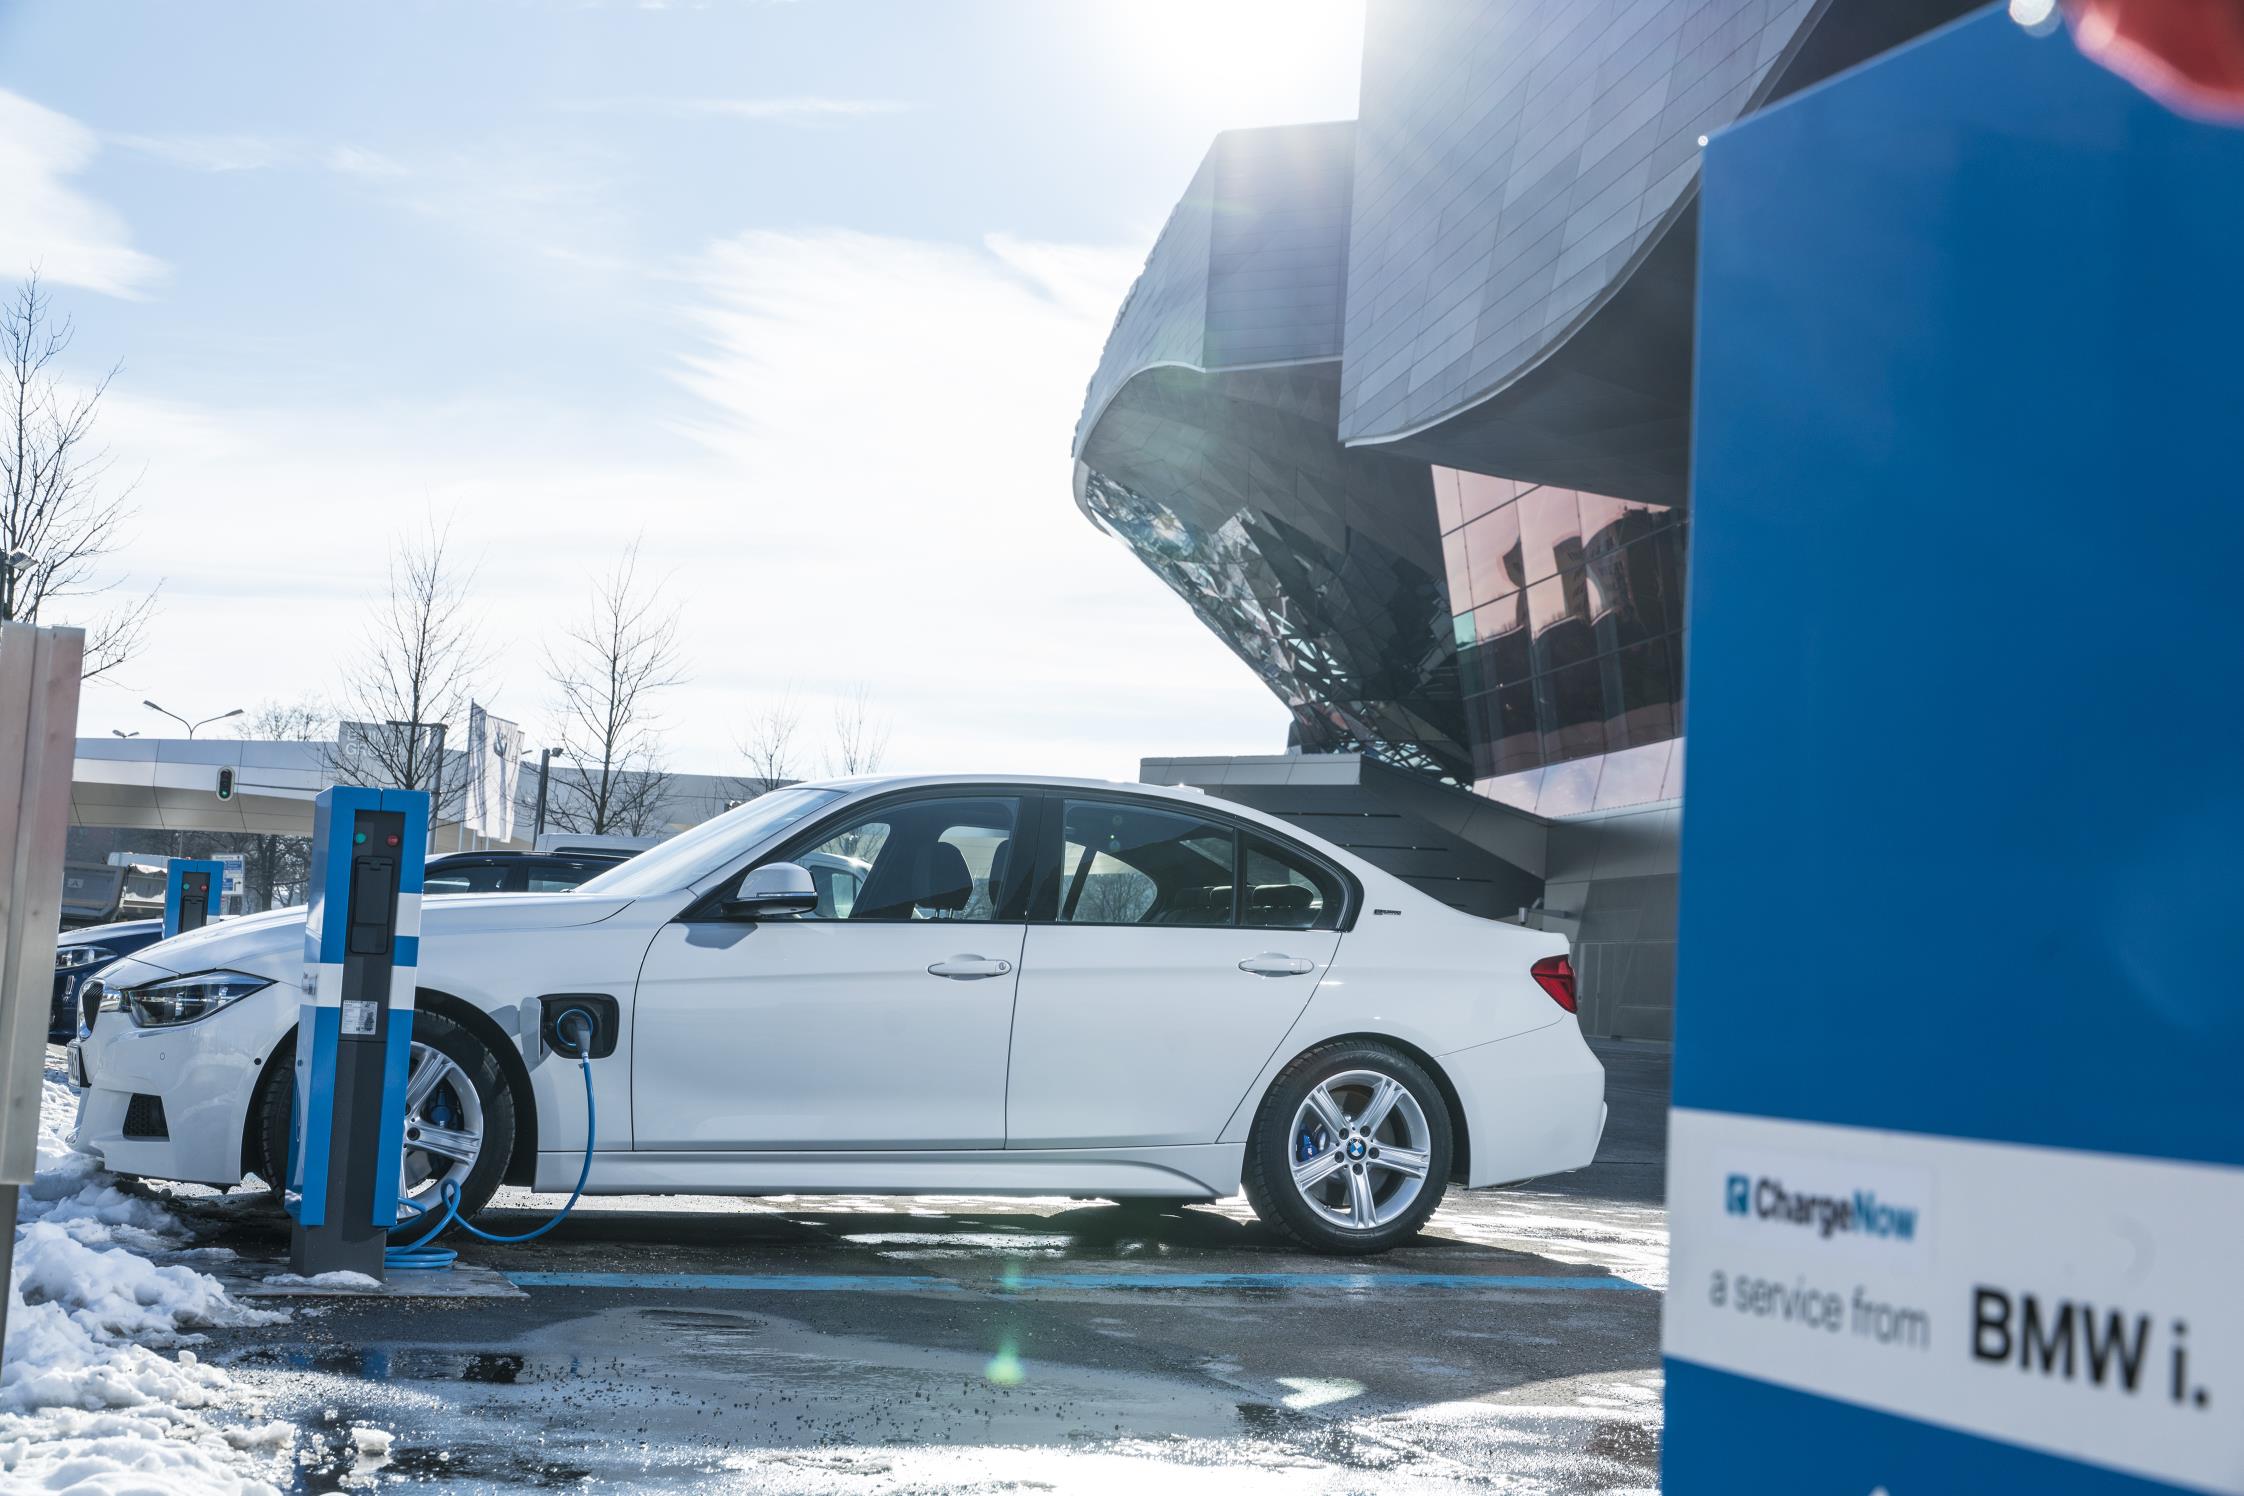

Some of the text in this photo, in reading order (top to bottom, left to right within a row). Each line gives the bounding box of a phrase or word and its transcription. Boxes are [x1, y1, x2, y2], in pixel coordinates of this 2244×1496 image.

[1754, 1176, 1918, 1241] ChargeNow
[1709, 1269, 2210, 1409] a service from BMW i.
